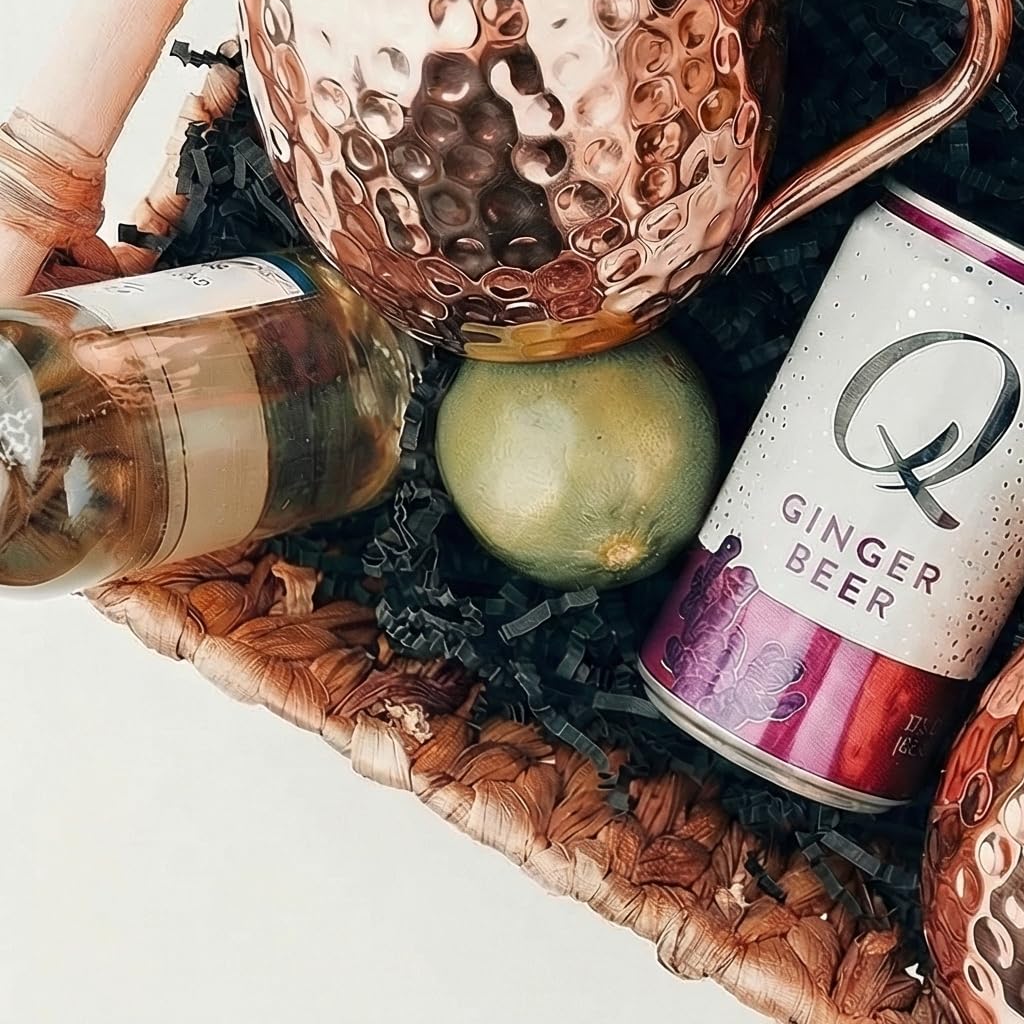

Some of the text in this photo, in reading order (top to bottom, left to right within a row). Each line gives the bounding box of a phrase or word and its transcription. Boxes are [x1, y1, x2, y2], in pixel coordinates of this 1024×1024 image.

[833, 331, 1022, 531] Q
[780, 493, 942, 596] GINGER
[784, 549, 896, 619] BEER
